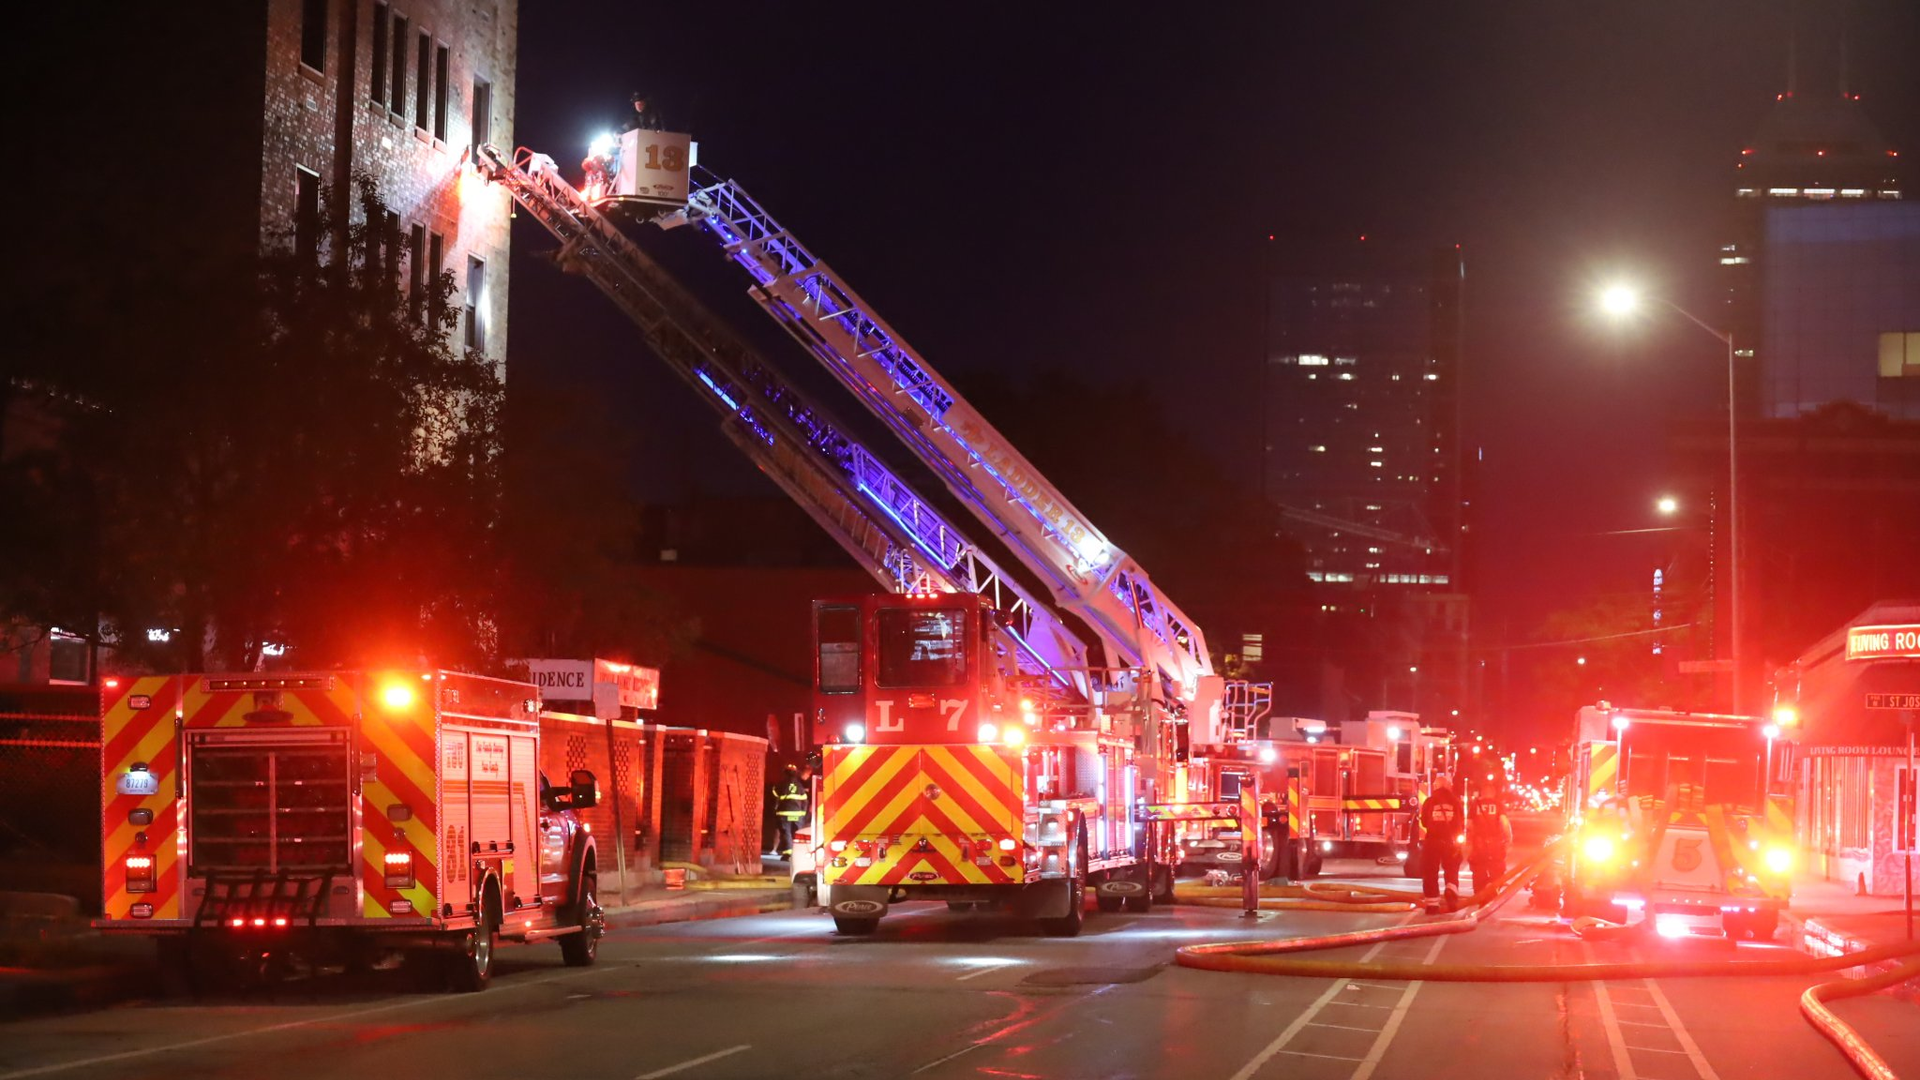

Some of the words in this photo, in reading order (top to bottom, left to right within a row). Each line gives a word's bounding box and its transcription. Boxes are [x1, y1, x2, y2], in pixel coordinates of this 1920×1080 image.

[644, 144, 685, 172] 13
[984, 444, 1064, 524] LADDER
[1062, 519, 1086, 543] 13
[532, 671, 585, 688] IDENCE
[875, 700, 904, 732] L
[940, 698, 969, 732] 7
[1889, 696, 1901, 707] ST
[1810, 746, 1836, 755] LIVING
[1838, 746, 1869, 755] ROOM
[1872, 746, 1920, 756] LOUNE
[1671, 837, 1703, 873] 5
